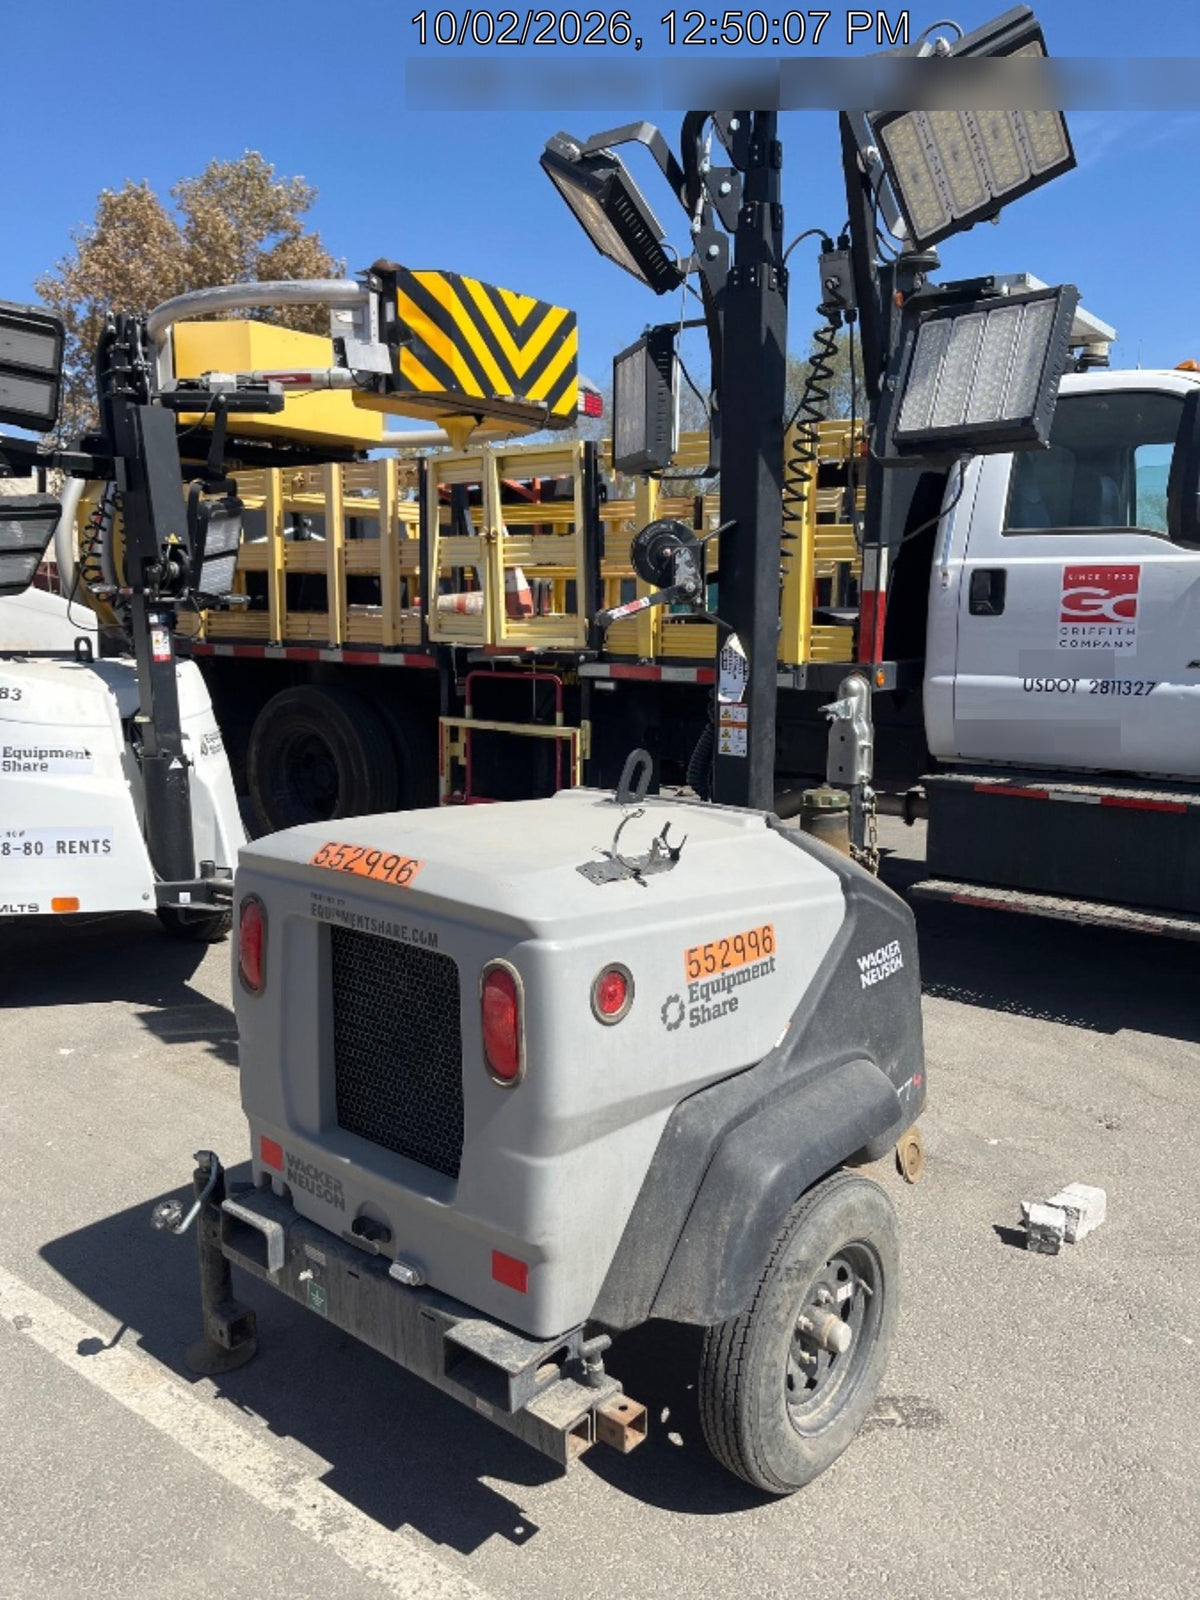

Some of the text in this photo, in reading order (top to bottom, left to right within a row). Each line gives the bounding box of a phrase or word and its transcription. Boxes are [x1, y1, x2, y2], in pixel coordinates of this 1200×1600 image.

[1058, 639, 1135, 649] COMPANY
[1059, 626, 1136, 636] GRIFFITH
[1023, 678, 1157, 697] USDOT 2811327
[1, 760, 49, 773] Share
[55, 839, 112, 855] RENTS
[313, 841, 419, 885] 552996
[310, 902, 440, 950] EQUIPMENTSHARE.COM
[688, 925, 774, 979] 552996
[856, 939, 902, 972] WACKER
[687, 955, 777, 1004] Equipment
[860, 953, 905, 990] NEUSON
[689, 996, 740, 1029] Share
[285, 1150, 344, 1197] WACKER
[286, 1167, 346, 1213] NEUSON
